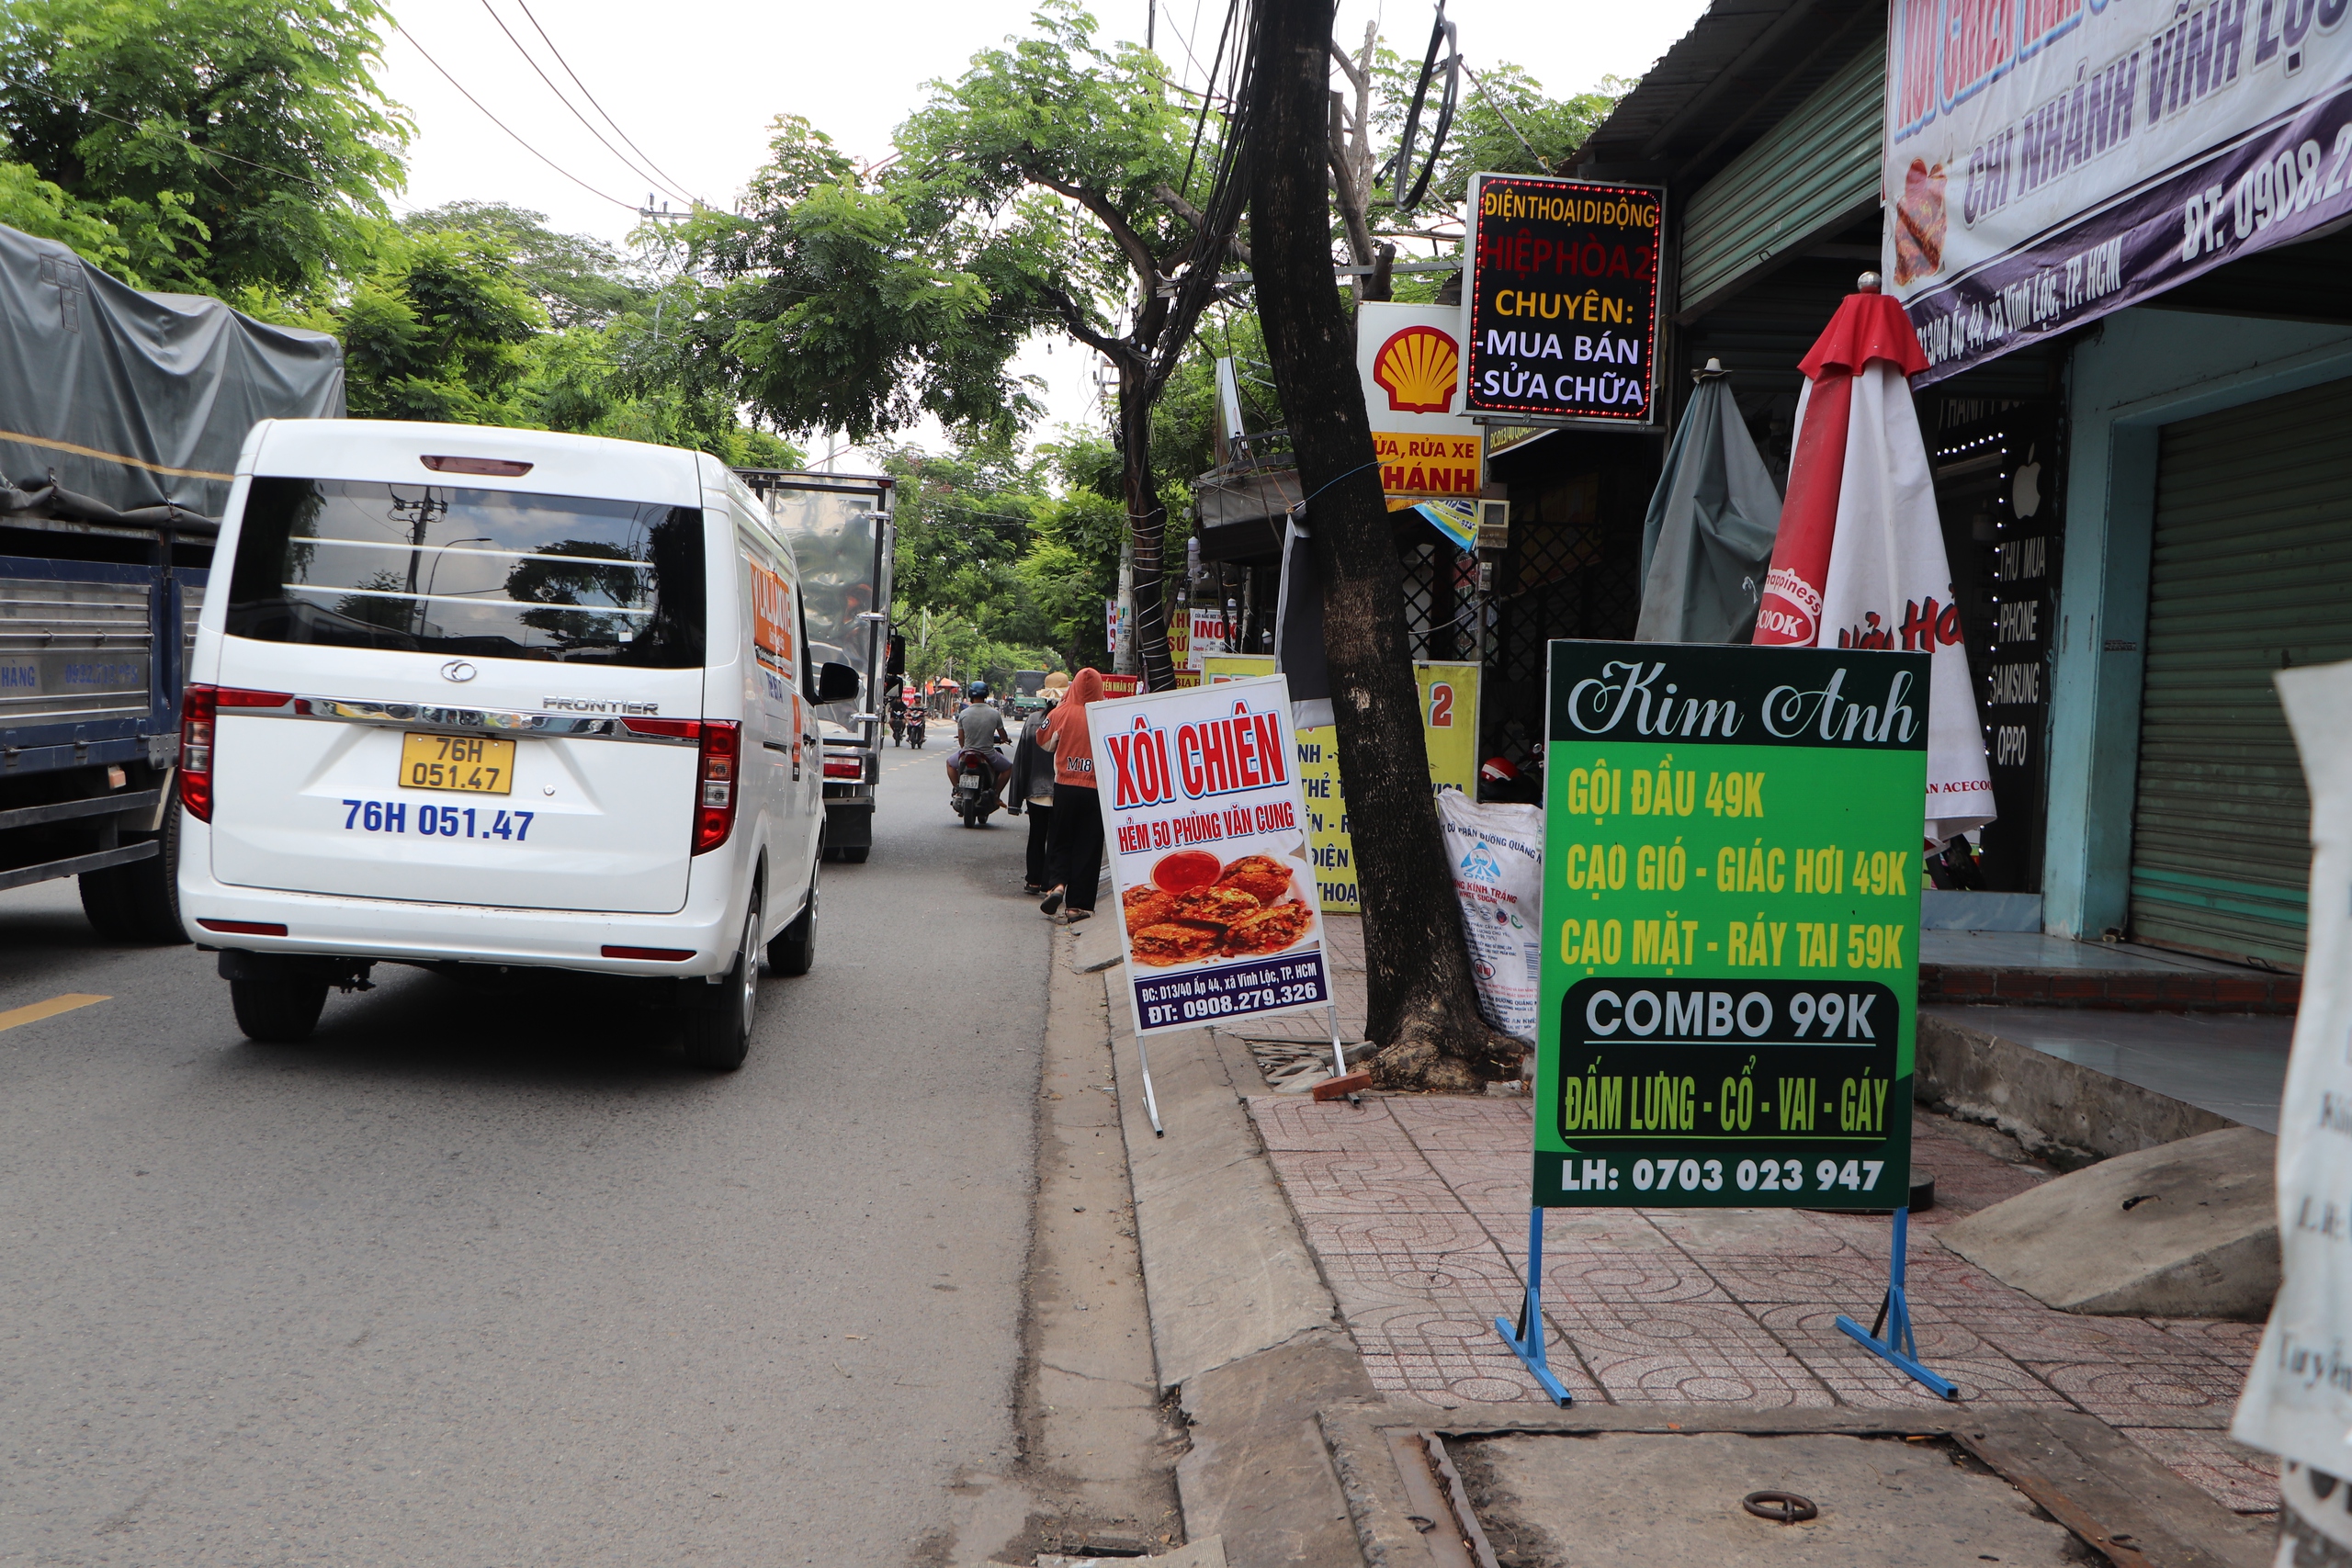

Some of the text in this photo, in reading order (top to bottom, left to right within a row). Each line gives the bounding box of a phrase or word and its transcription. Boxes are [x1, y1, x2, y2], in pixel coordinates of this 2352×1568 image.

[1962, 127, 2014, 228] CHI
[2020, 55, 2140, 195] NHÁNH
[1485, 187, 1655, 231] ĐIỆN THOẠI DI ĐỘNG
[2182, 121, 2352, 263] ĐT: 0908.2
[1481, 227, 1653, 280] HIỆP HÒA 2
[1495, 288, 1634, 324] CHUYÊN:
[1951, 292, 1965, 360] Ấp
[1986, 290, 2004, 343] xã
[2004, 282, 2030, 334] Vĩnh
[2065, 254, 2083, 310] TP.
[2086, 236, 2121, 302] HCM
[1574, 331, 1639, 365] BÁN
[1555, 372, 1645, 406] CHỮA
[1409, 437, 1447, 458] RỬA
[1452, 443, 1475, 458] XE
[1379, 462, 1476, 492] HÁNH
[1999, 536, 2046, 581] THU MUA
[1998, 600, 2038, 643] IPHONE
[2, 660, 36, 687] HÀNG
[1989, 661, 2040, 705] SAMSUNG
[543, 695, 659, 716] FRONTIER
[1430, 682, 1454, 728] 2
[1567, 660, 1919, 743] Kim Anh
[436, 738, 483, 763] 76H
[1067, 757, 1092, 773] M18
[1106, 701, 1287, 808] XÔI CHIÊN
[1997, 724, 2027, 767] OPPO
[413, 762, 501, 791] 051.47
[1567, 752, 1766, 826] GỘI ĐẦU 49K
[342, 799, 535, 842] 76H 051.47
[1117, 816, 1151, 852] HẺM
[1153, 820, 1171, 848] 50
[1172, 809, 1222, 844] PHÙNG
[1222, 805, 1255, 837] VĂN
[1255, 801, 1295, 832] CUNG
[1467, 882, 1488, 894] KÍNH
[1566, 843, 1626, 900] CẠO
[1636, 836, 1687, 892] GIÓ
[1716, 838, 1785, 893] GIÁC
[1794, 843, 1843, 894] HƠI
[1851, 851, 1908, 896] 49K
[1560, 918, 1623, 975] CẠO
[1632, 909, 1699, 976] MẶT
[1727, 911, 1788, 966] RÁY
[1795, 922, 1838, 967] TAI
[1847, 924, 1905, 969] 59K
[1142, 962, 1317, 1003] ĐC: D13/40 Ấp 44, xã Vĩnh Lộc, TP. HCM
[1148, 982, 1318, 1024] ĐT: 0908.279.326
[1586, 989, 1876, 1039] COMBO 99K
[1565, 1055, 1623, 1132] ĐẤM
[1631, 1070, 1695, 1131] LƯNG
[1720, 1055, 1756, 1132] CỔ
[1779, 1077, 1816, 1131] VAI
[1840, 1066, 1889, 1132] GÁY
[1561, 1158, 1885, 1192] LH: 0703 023 947
